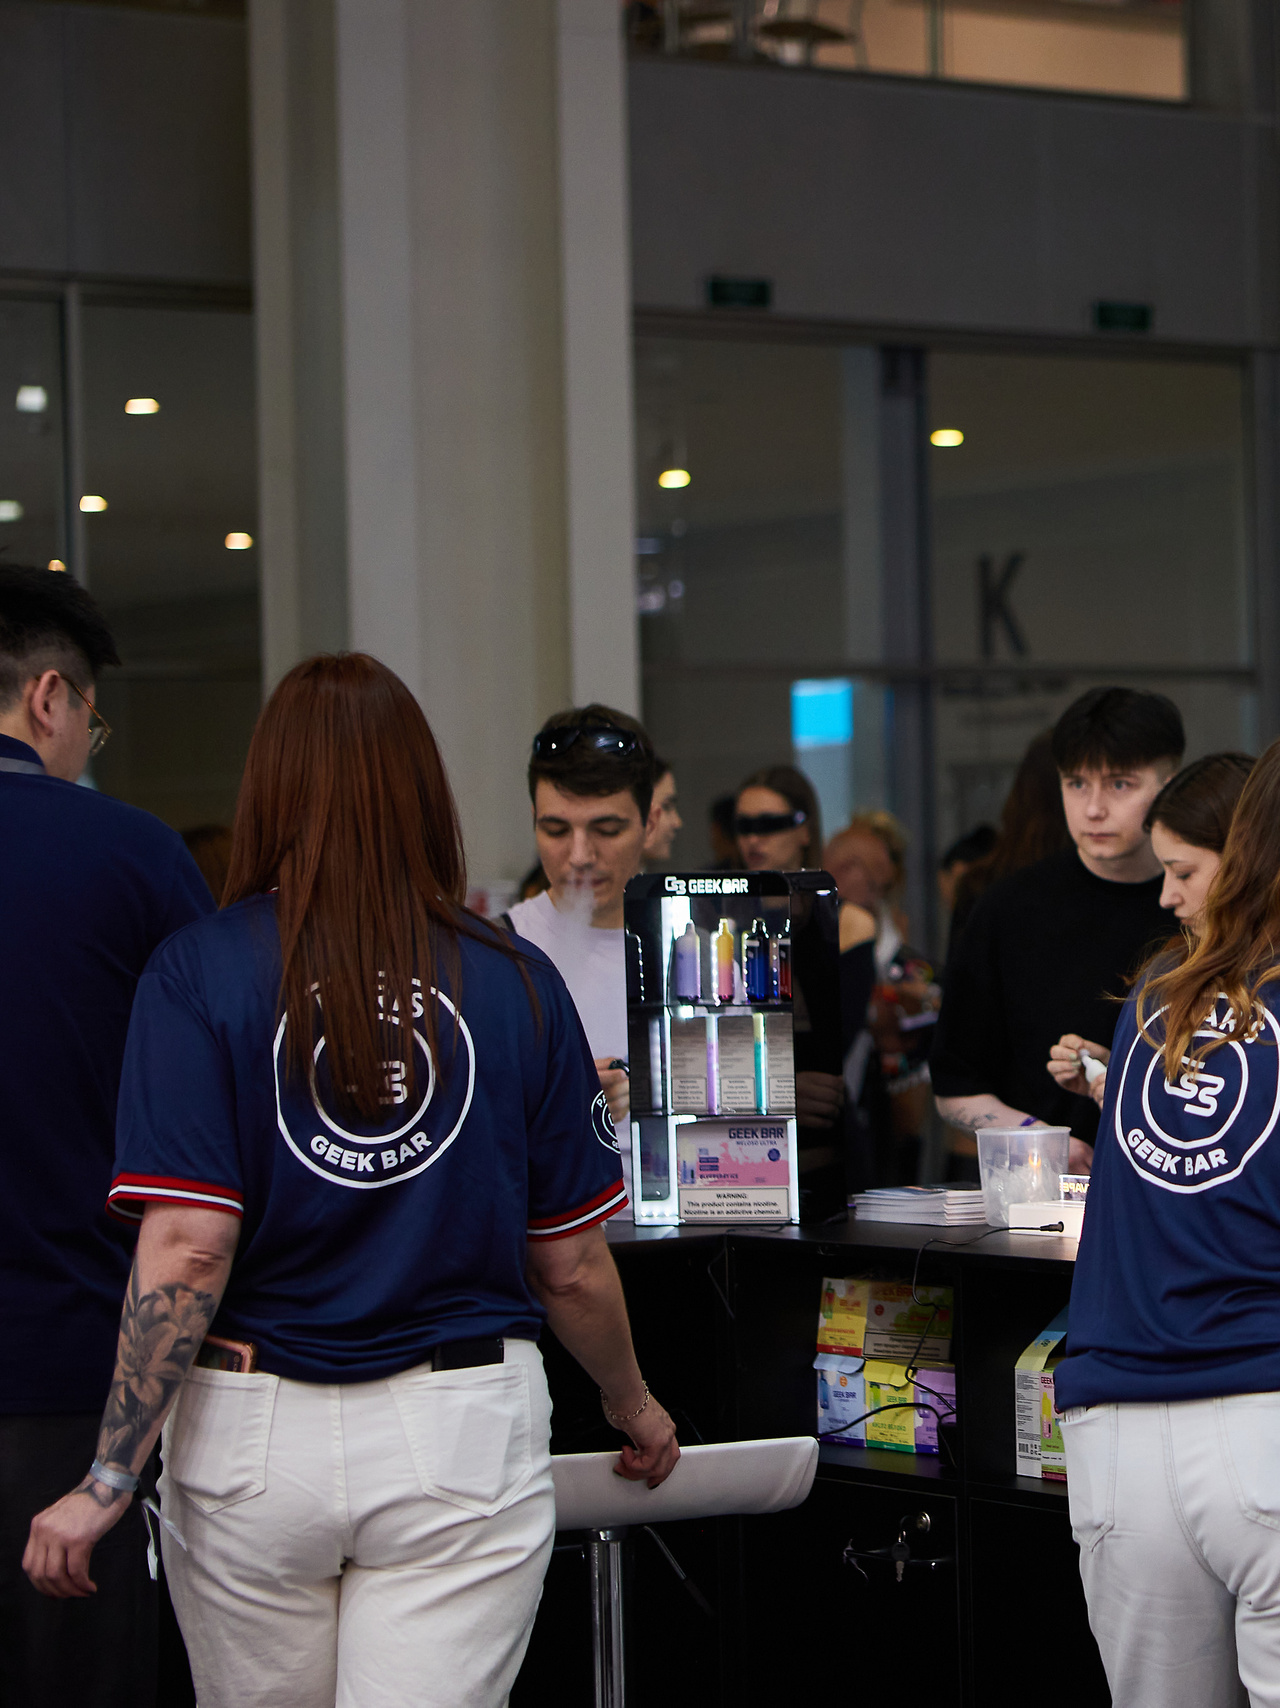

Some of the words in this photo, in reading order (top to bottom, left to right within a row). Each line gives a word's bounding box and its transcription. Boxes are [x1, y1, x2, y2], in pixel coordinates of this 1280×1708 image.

[977, 550, 1028, 659] K
[688, 878, 722, 894] GEEK
[722, 878, 749, 894] BAR
[310, 1135, 375, 1172] GEEK
[380, 1131, 432, 1170] BAR
[728, 1127, 759, 1139] GEEK
[760, 1127, 784, 1139] BAR
[1126, 1128, 1181, 1175] GEEK
[1184, 1147, 1229, 1176] BAR
